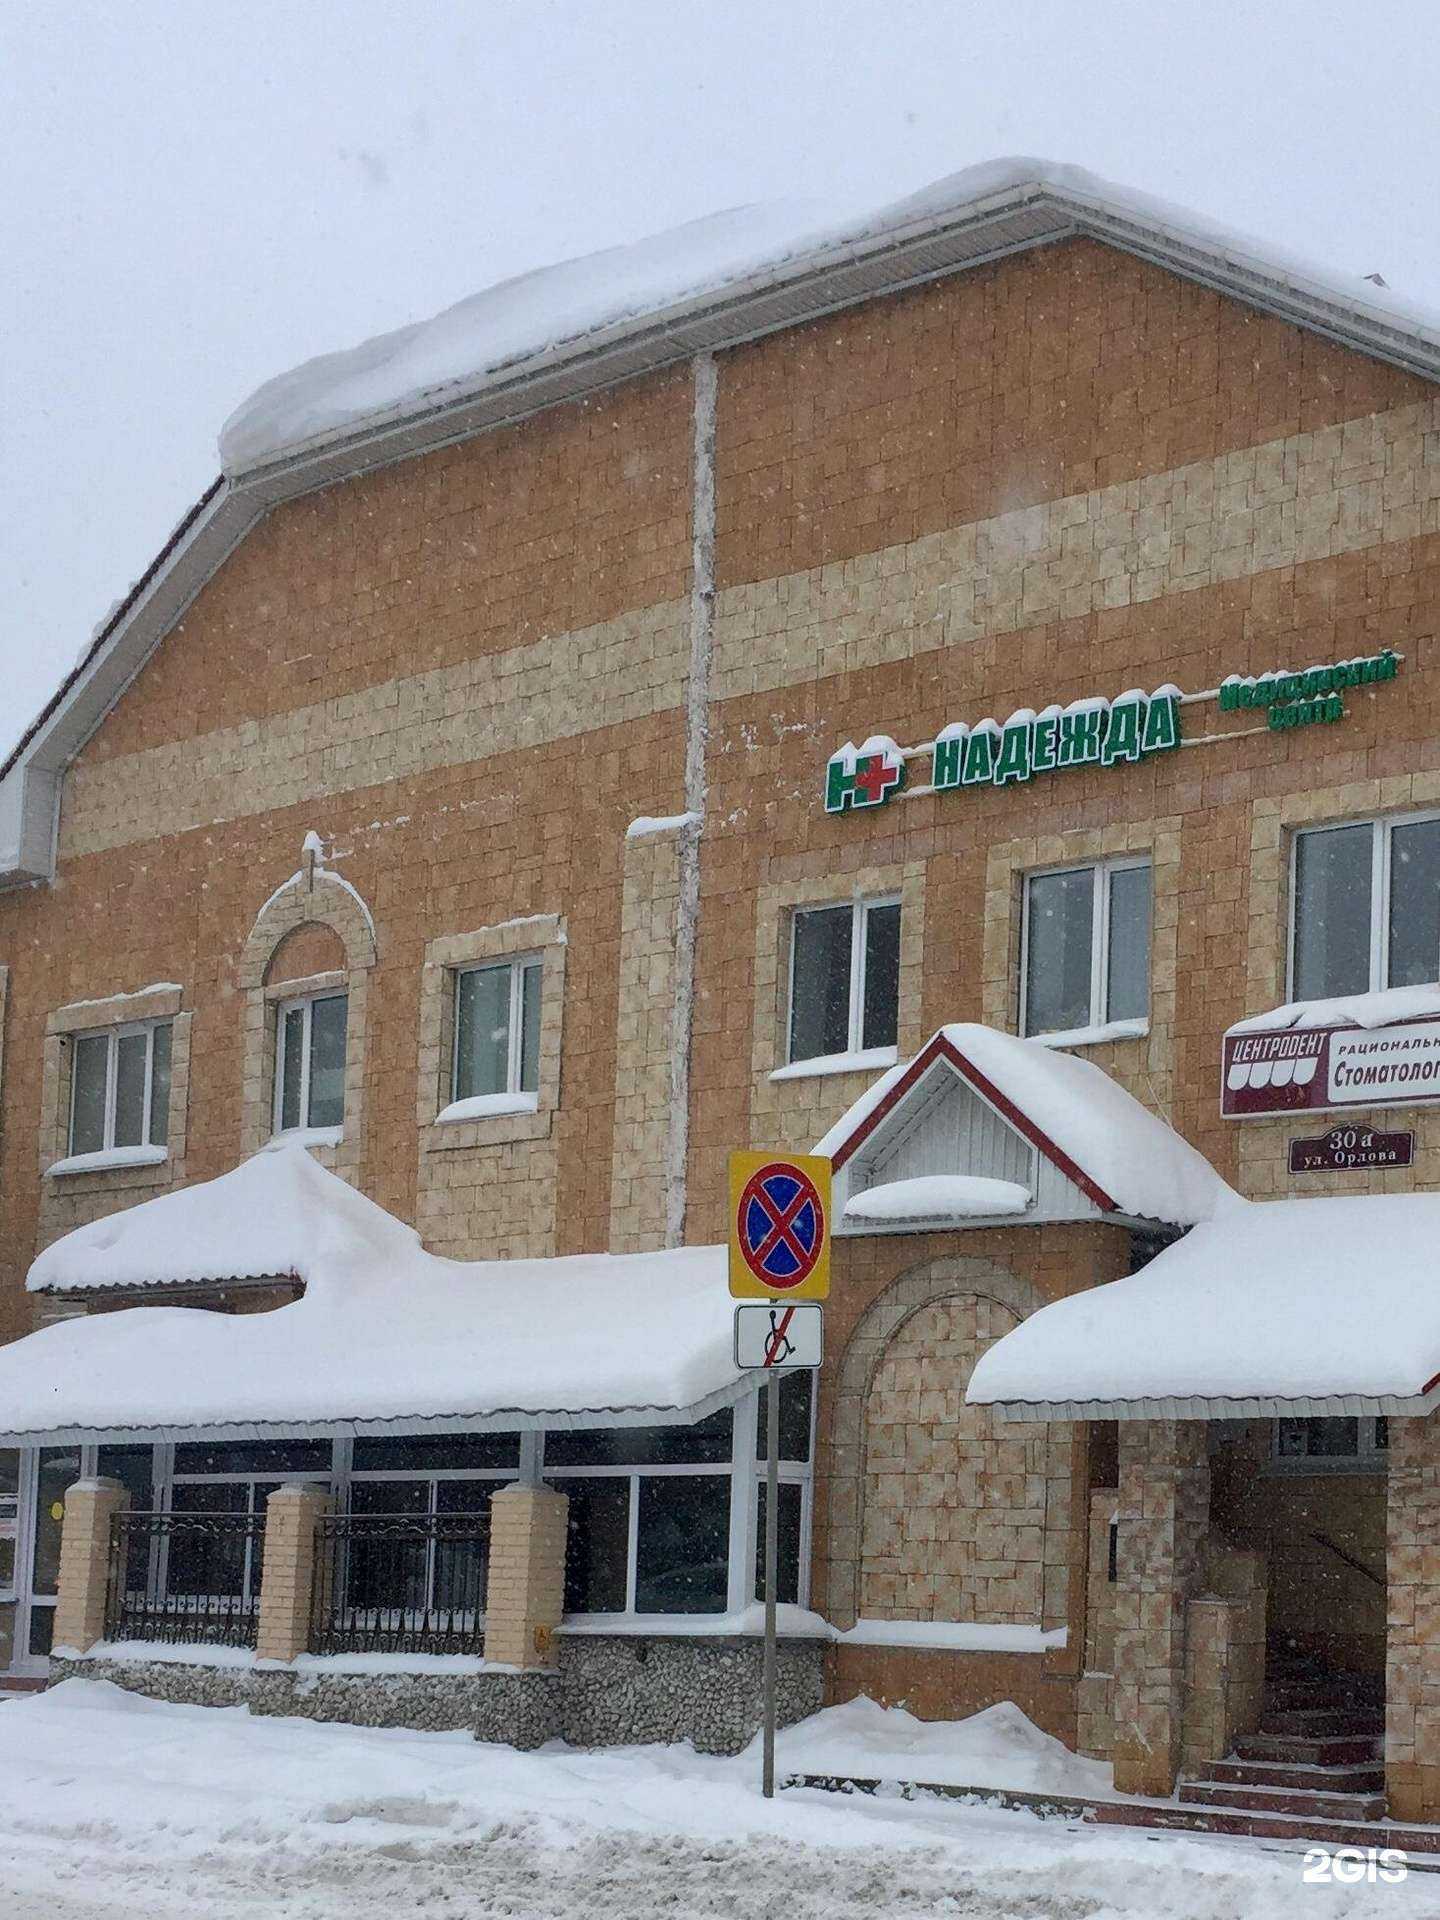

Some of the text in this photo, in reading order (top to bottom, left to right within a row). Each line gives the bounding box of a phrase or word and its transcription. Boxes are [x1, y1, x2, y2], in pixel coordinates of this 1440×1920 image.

[932, 694, 1182, 790] НАДЕЖДА
[1232, 1032, 1327, 1062] ЦЕНТРОДЕНТ
[1304, 1150, 1396, 1168] ул. Орлова
